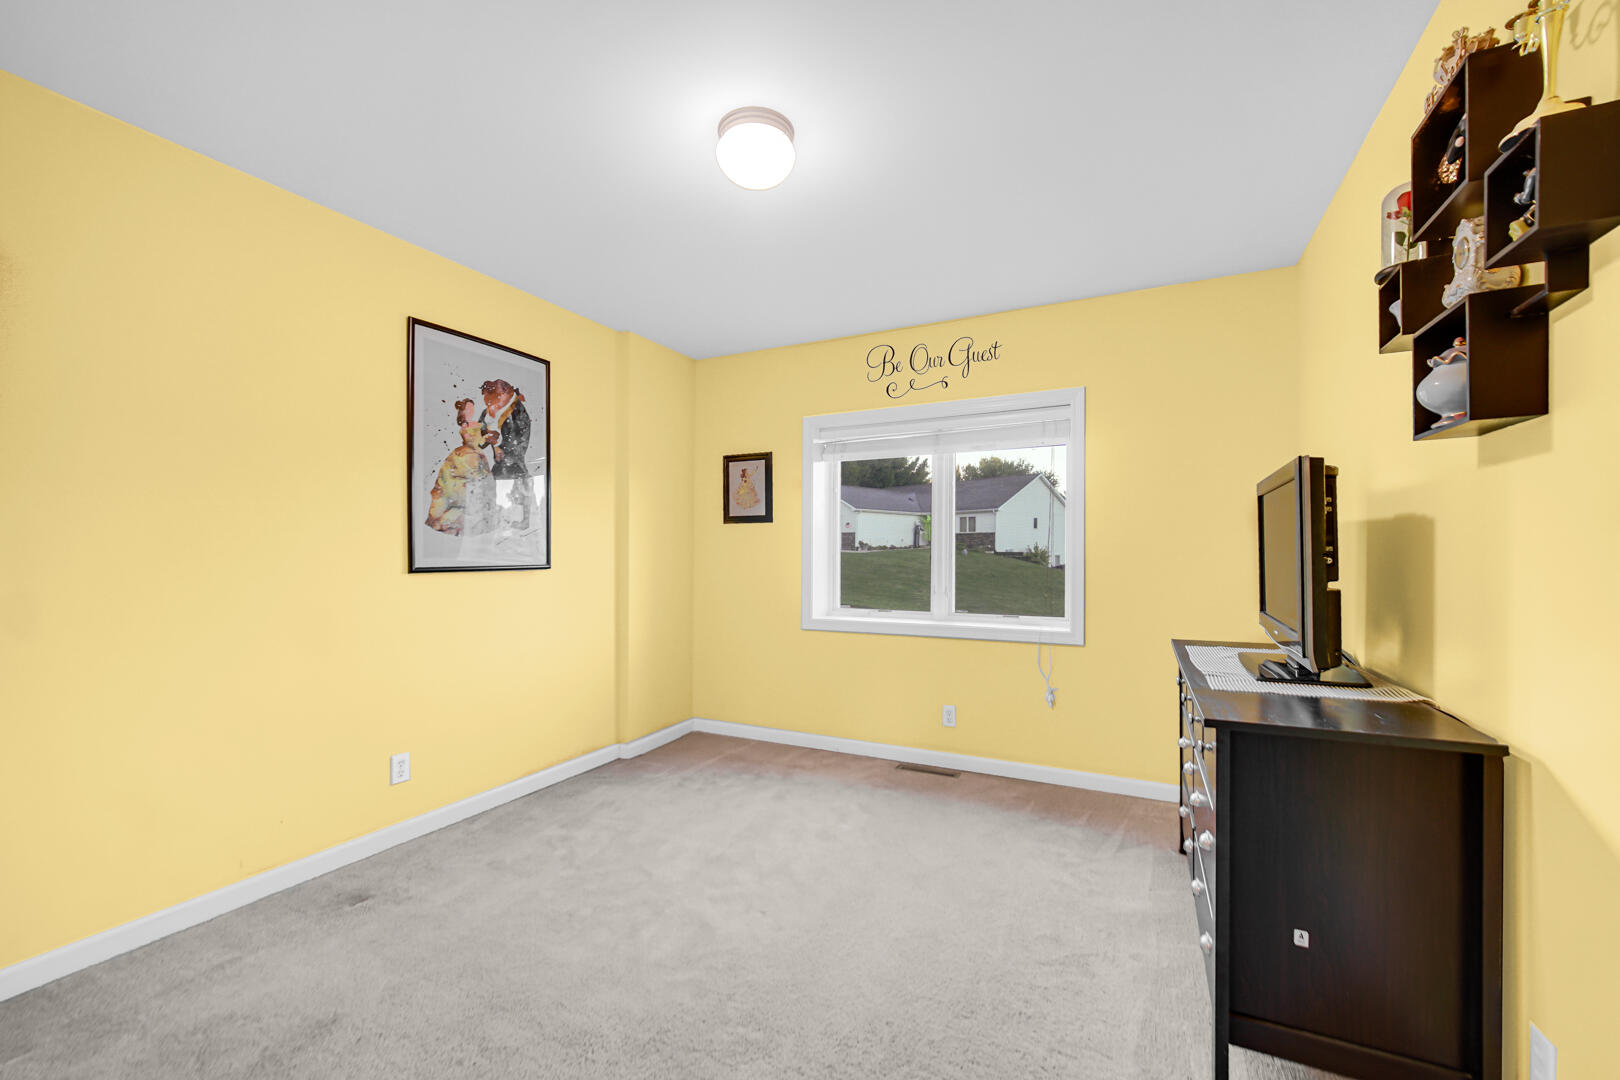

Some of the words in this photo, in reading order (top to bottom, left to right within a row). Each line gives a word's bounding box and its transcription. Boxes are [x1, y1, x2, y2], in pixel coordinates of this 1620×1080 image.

[866, 344, 903, 382] Be
[909, 343, 945, 375] Our
[948, 336, 1003, 379] Guest
